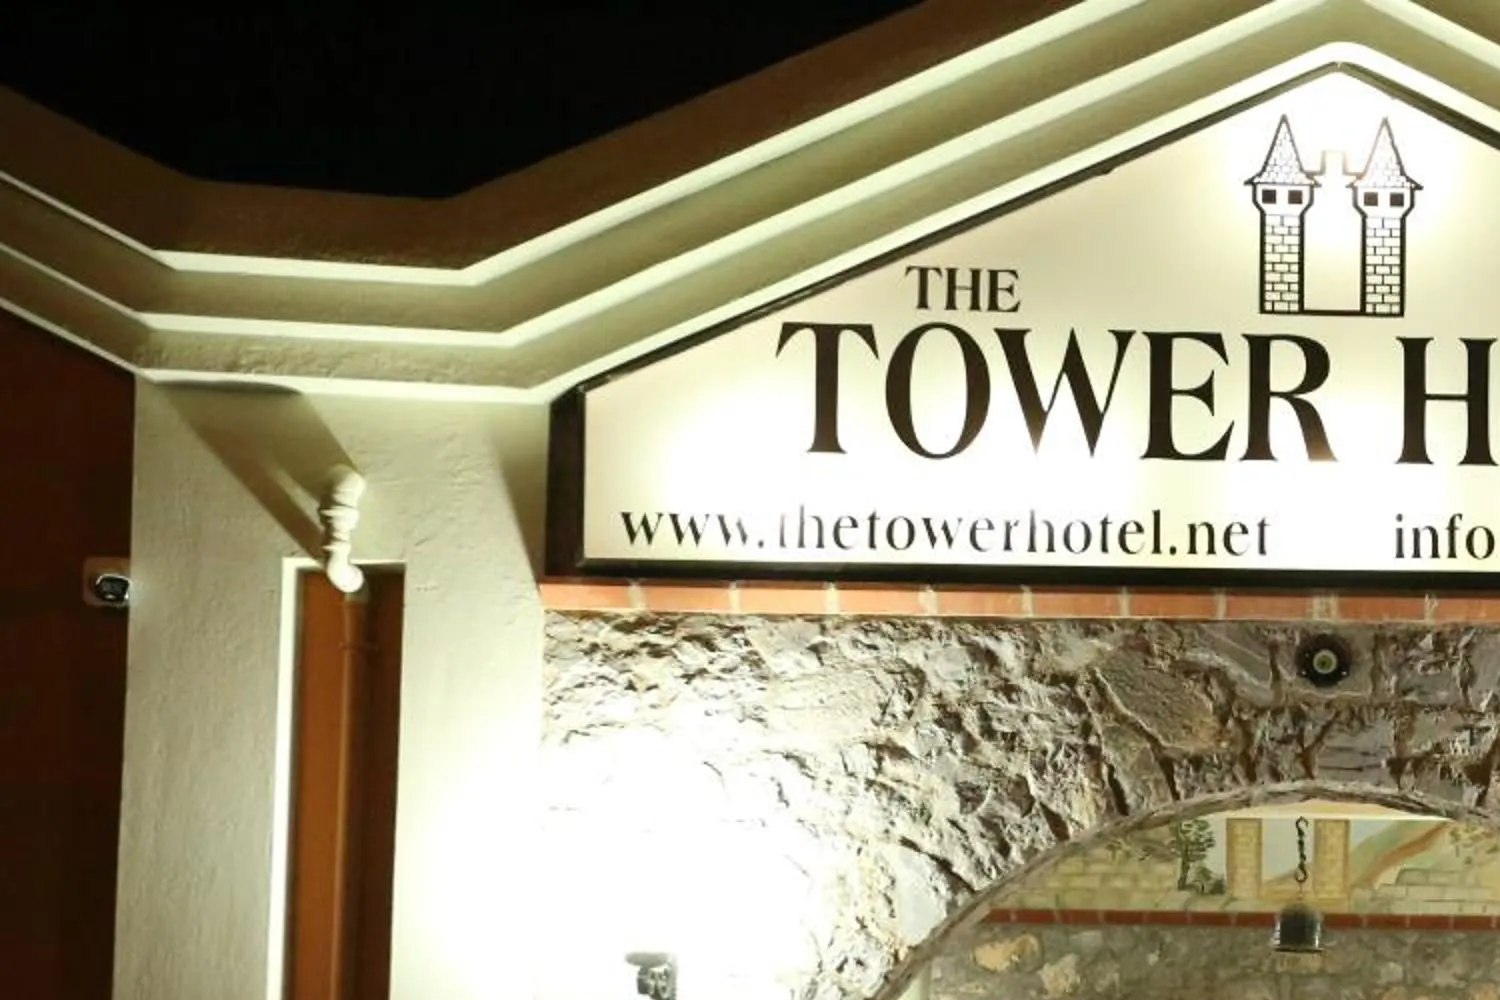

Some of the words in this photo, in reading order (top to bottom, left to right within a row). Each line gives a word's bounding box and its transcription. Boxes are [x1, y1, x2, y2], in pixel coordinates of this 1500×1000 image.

[905, 265, 1020, 312] THE
[775, 321, 1338, 460] TOWER
[620, 504, 1270, 557] www.thetowerhotel.net
